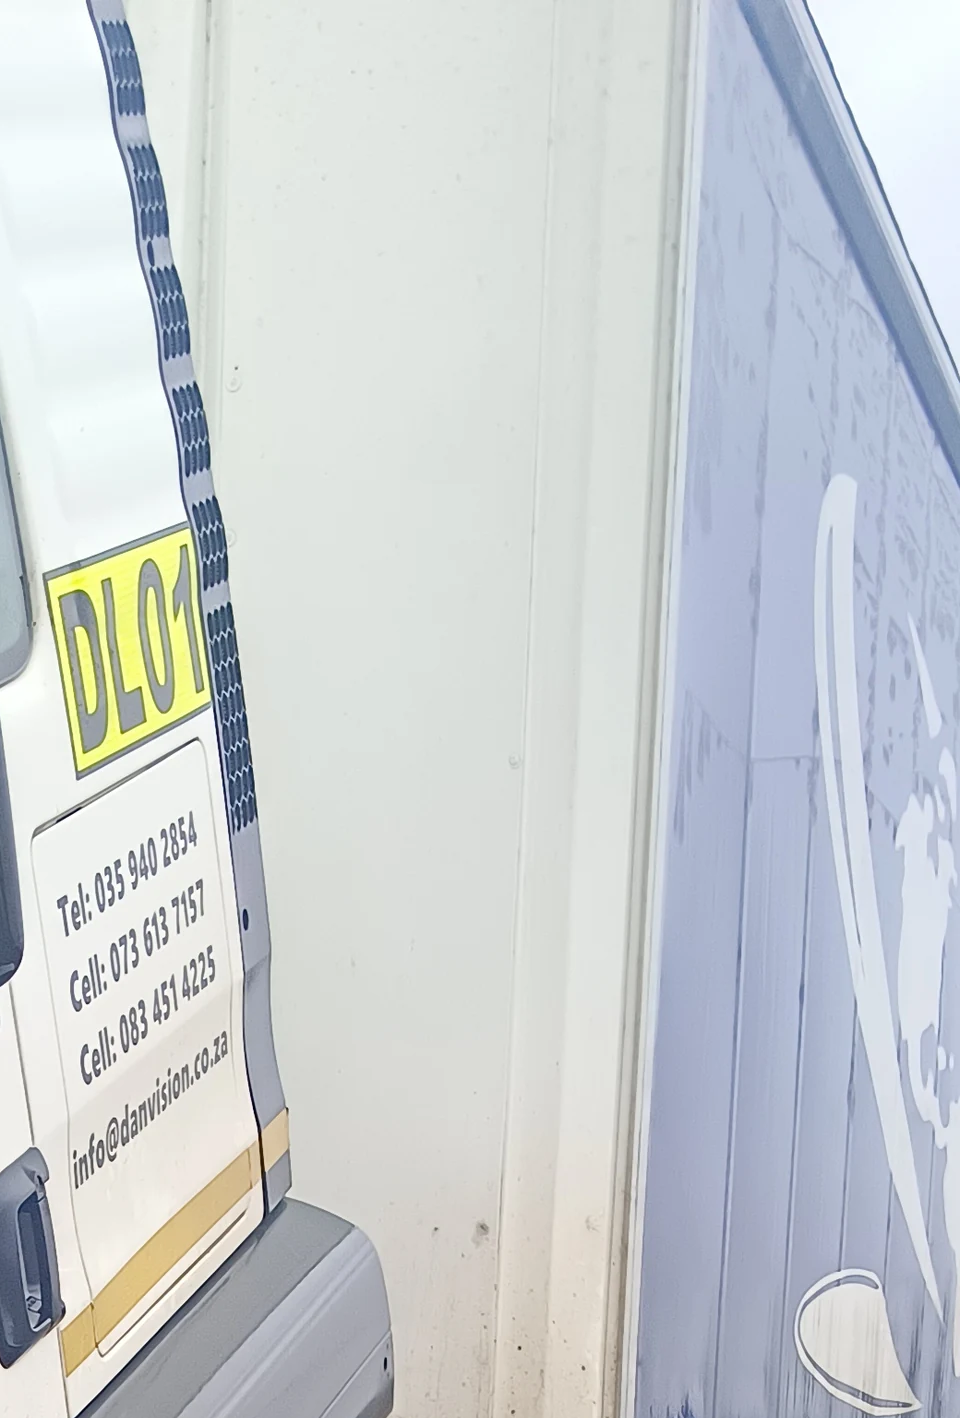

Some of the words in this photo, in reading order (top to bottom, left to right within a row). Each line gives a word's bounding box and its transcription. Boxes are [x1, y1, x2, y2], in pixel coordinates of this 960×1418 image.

[58, 544, 205, 754] DL01
[56, 883, 92, 937] Tel:
[94, 859, 125, 913] 035
[128, 837, 158, 890] 940
[160, 811, 197, 868] 2854
[70, 954, 107, 1012] Cell:
[109, 928, 140, 982] 073
[143, 906, 169, 957] 613
[171, 878, 204, 934] 7157
[80, 1026, 117, 1085] Cell:
[119, 999, 148, 1053] 083
[152, 974, 179, 1025] 451
[182, 945, 216, 1001] 4225
[73, 1030, 228, 1189] info@danvision.co.za
